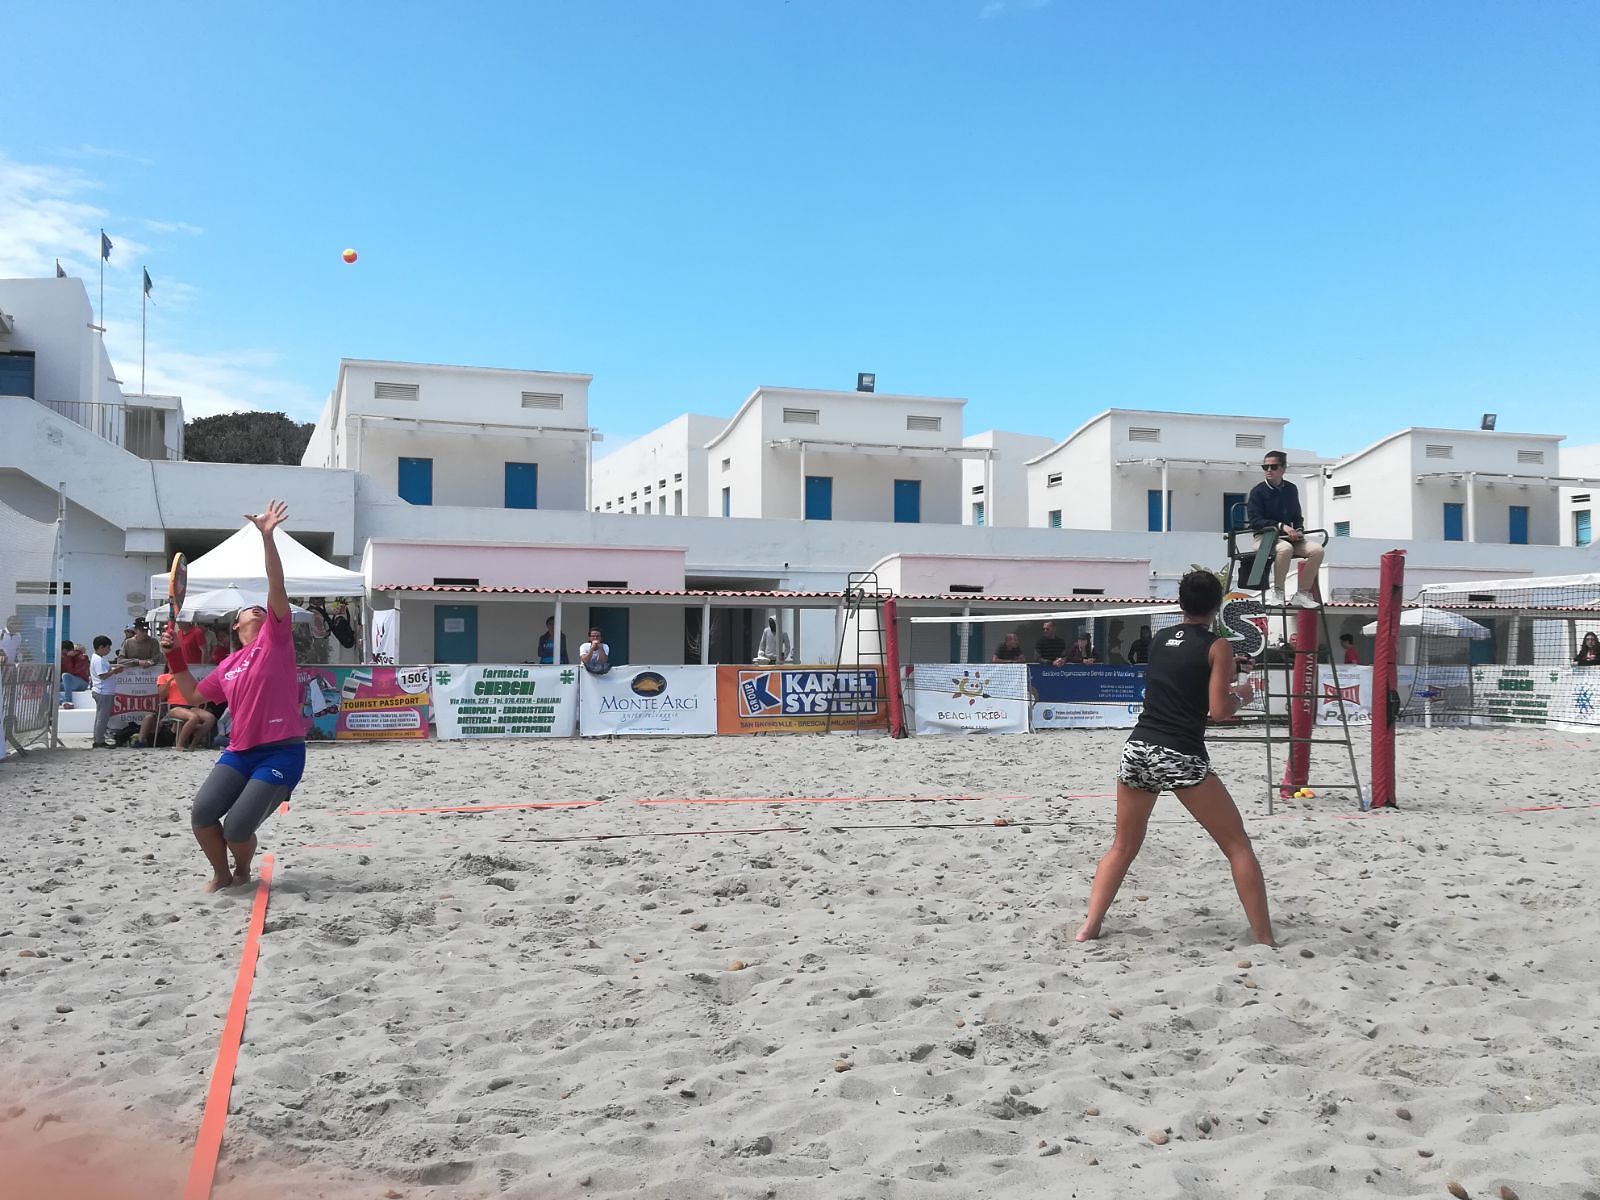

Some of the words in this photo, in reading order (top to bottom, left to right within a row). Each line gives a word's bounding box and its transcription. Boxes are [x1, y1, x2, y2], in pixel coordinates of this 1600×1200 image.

[482, 668, 529, 679] farmacia
[474, 681, 536, 696] CHERCHI
[785, 673, 872, 692] KARTEL
[113, 695, 159, 713] S.LUCI
[344, 700, 377, 710] TOURIST
[379, 697, 420, 707] PASSPORT
[600, 696, 657, 712] MONTE
[744, 683, 760, 713] GROUP
[785, 693, 873, 713] SYSTEM
[937, 711, 972, 720] BEACH
[797, 720, 826, 728] BRESCIA
